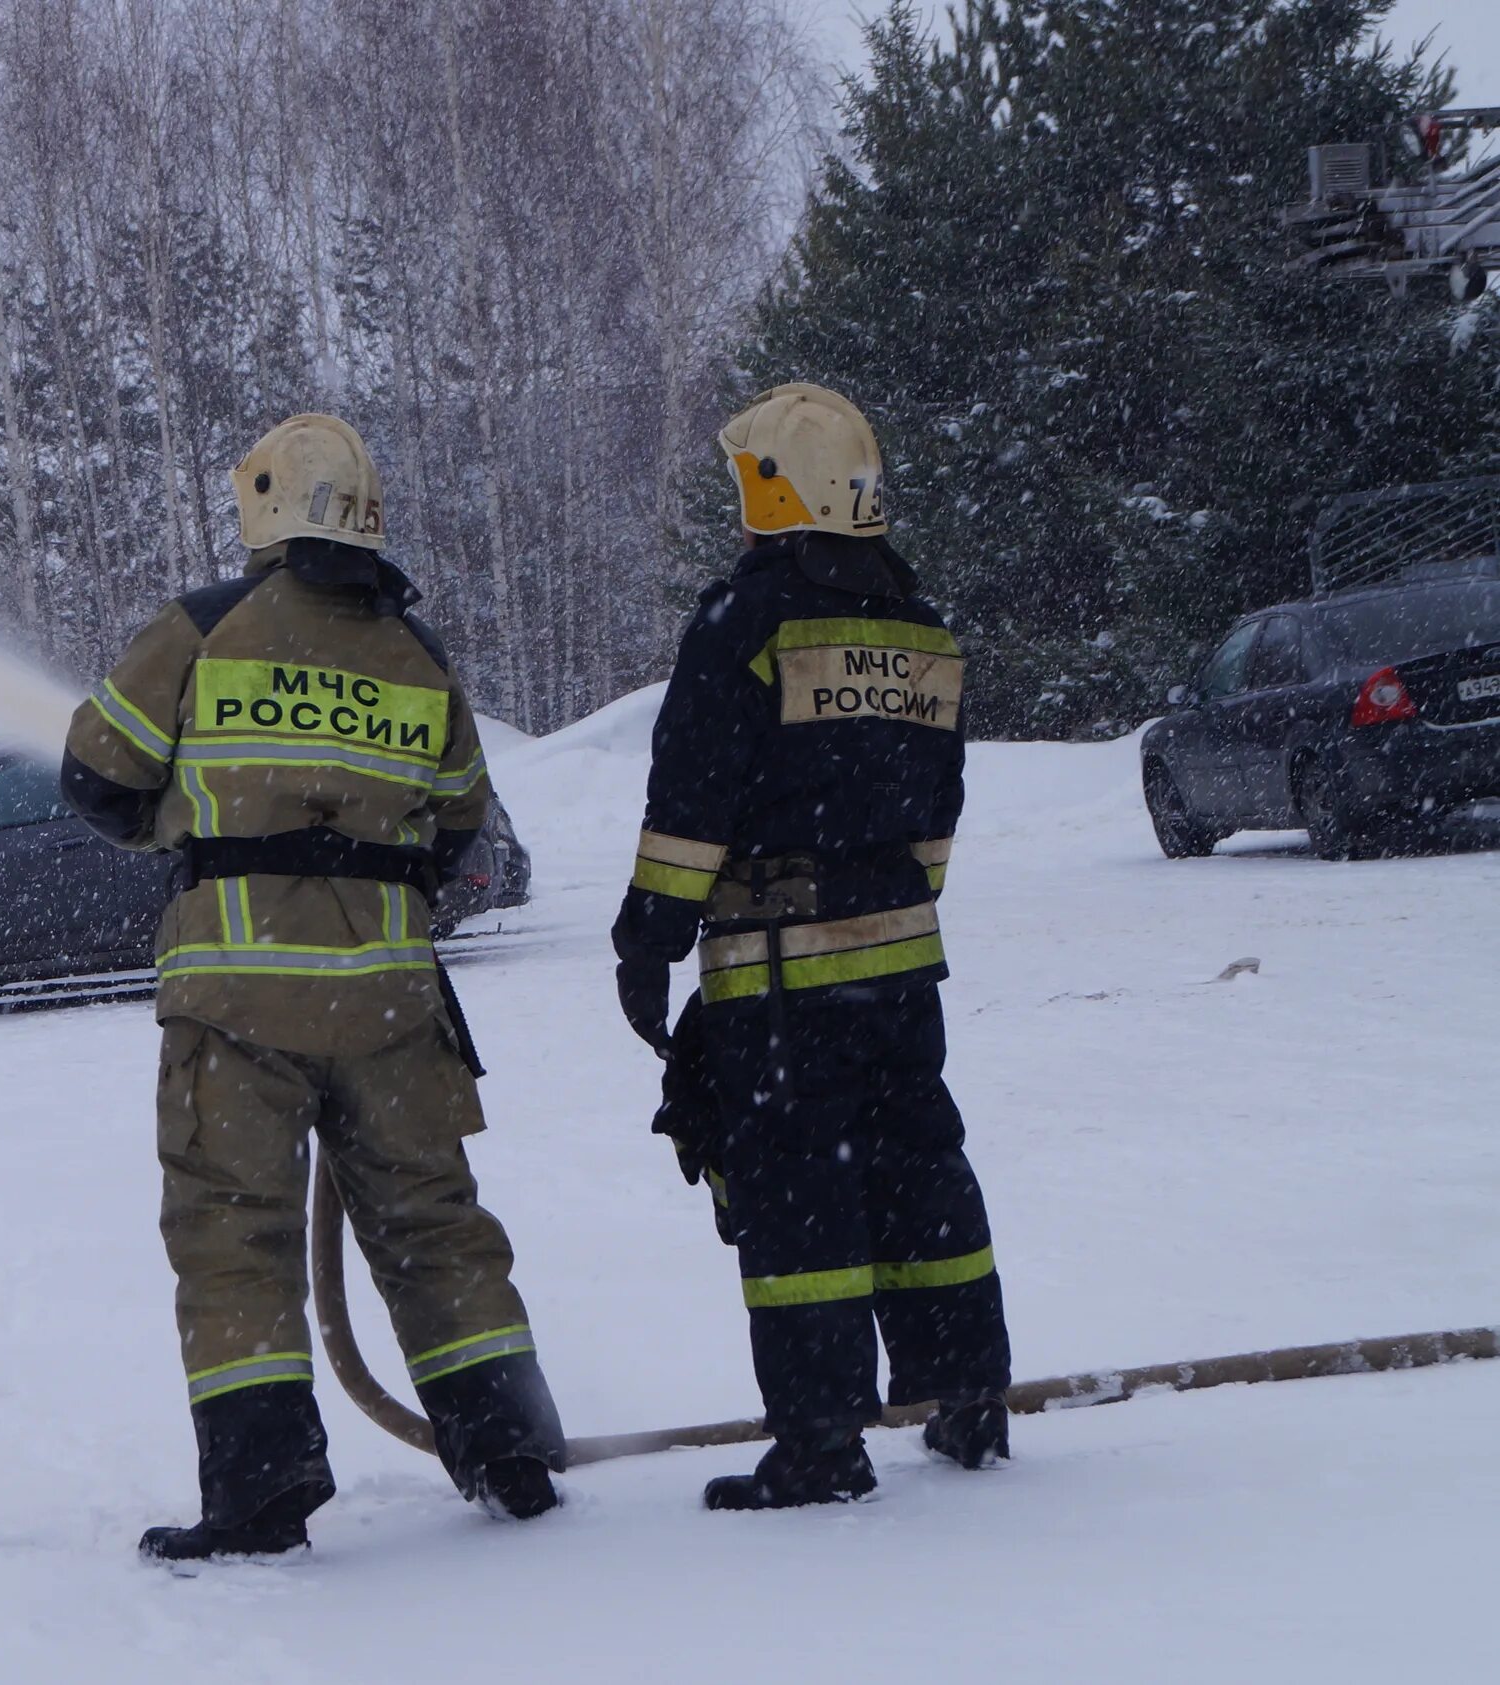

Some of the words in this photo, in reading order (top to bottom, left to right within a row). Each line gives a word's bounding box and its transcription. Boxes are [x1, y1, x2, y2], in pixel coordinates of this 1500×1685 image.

[338, 492, 380, 534] 75
[844, 649, 910, 679] МЧС
[272, 666, 380, 707] МЧС
[813, 686, 938, 721] РОССИИ
[215, 698, 429, 750] РОССИИ
